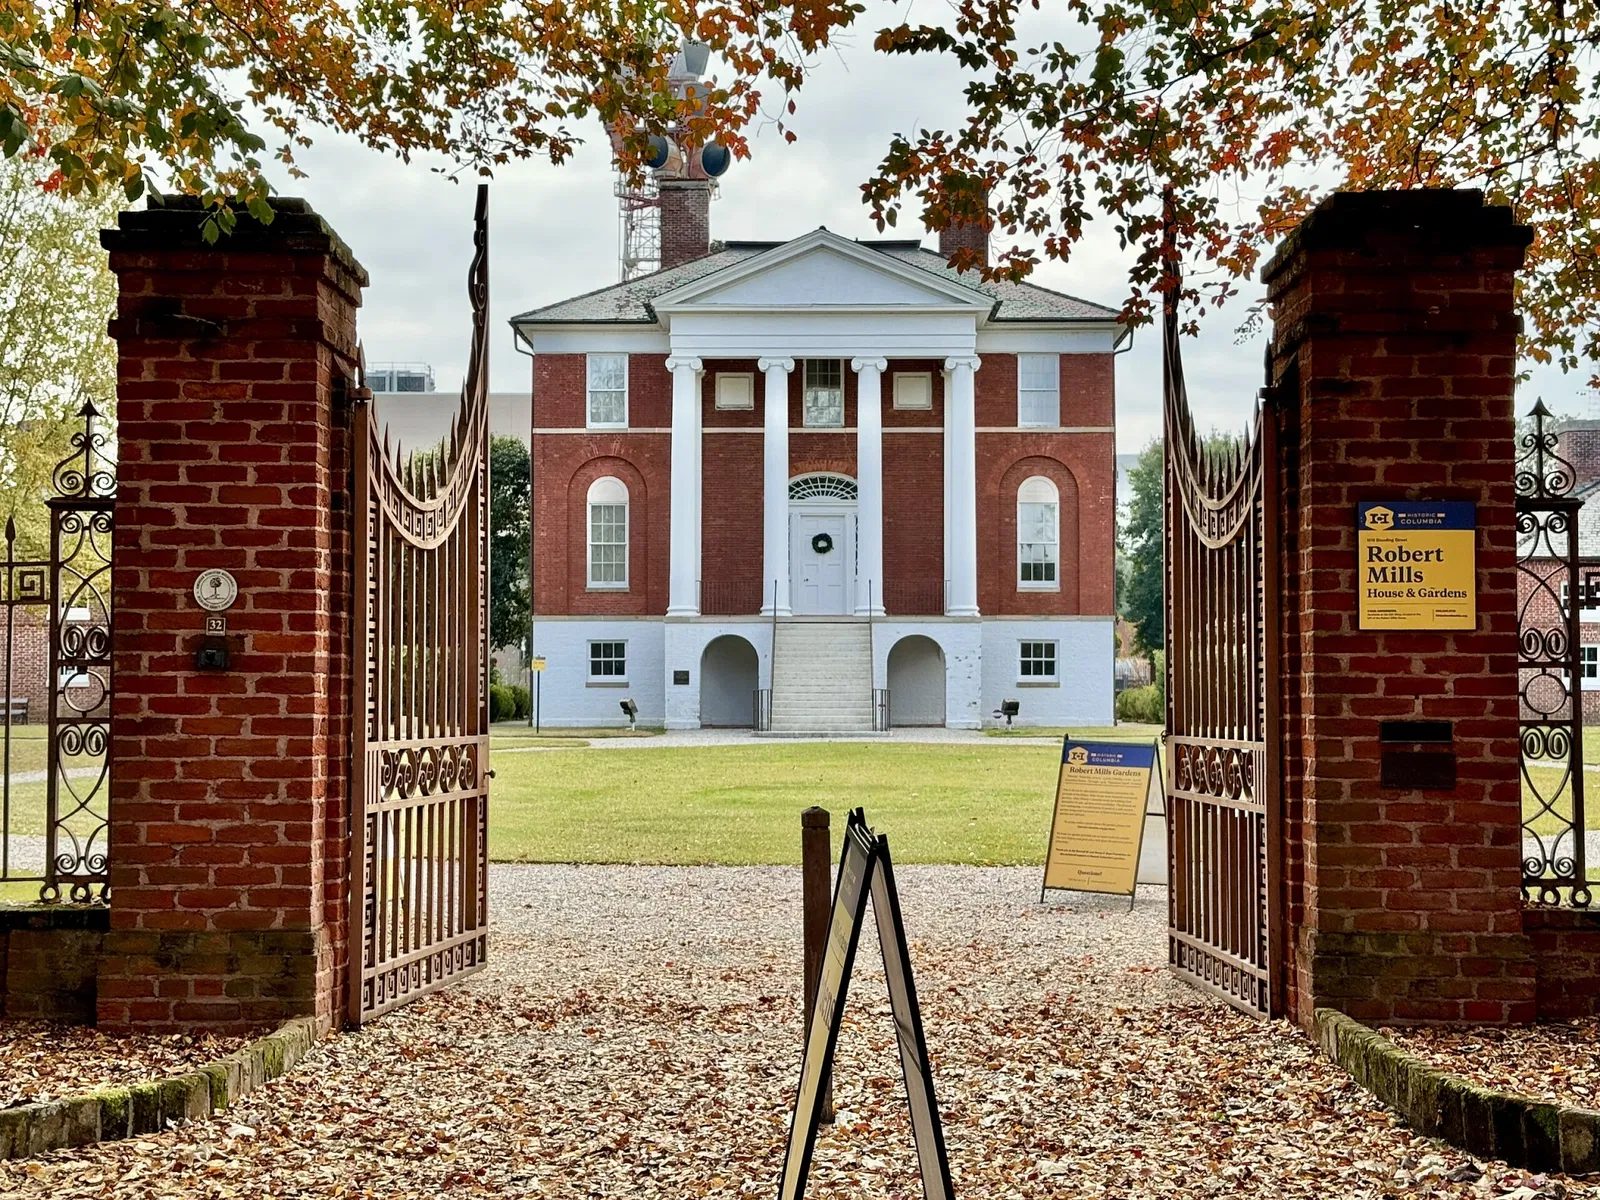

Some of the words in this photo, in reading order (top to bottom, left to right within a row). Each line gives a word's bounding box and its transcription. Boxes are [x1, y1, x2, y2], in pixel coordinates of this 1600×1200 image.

[1366, 545, 1444, 562] Robert
[1366, 566, 1424, 583] Mills
[1367, 588, 1404, 598] House
[1405, 588, 1416, 598] &
[1418, 588, 1468, 598] Gardens
[209, 620, 222, 630] 32
[1069, 766, 1093, 775] Robert
[1112, 769, 1141, 777] Gardens
